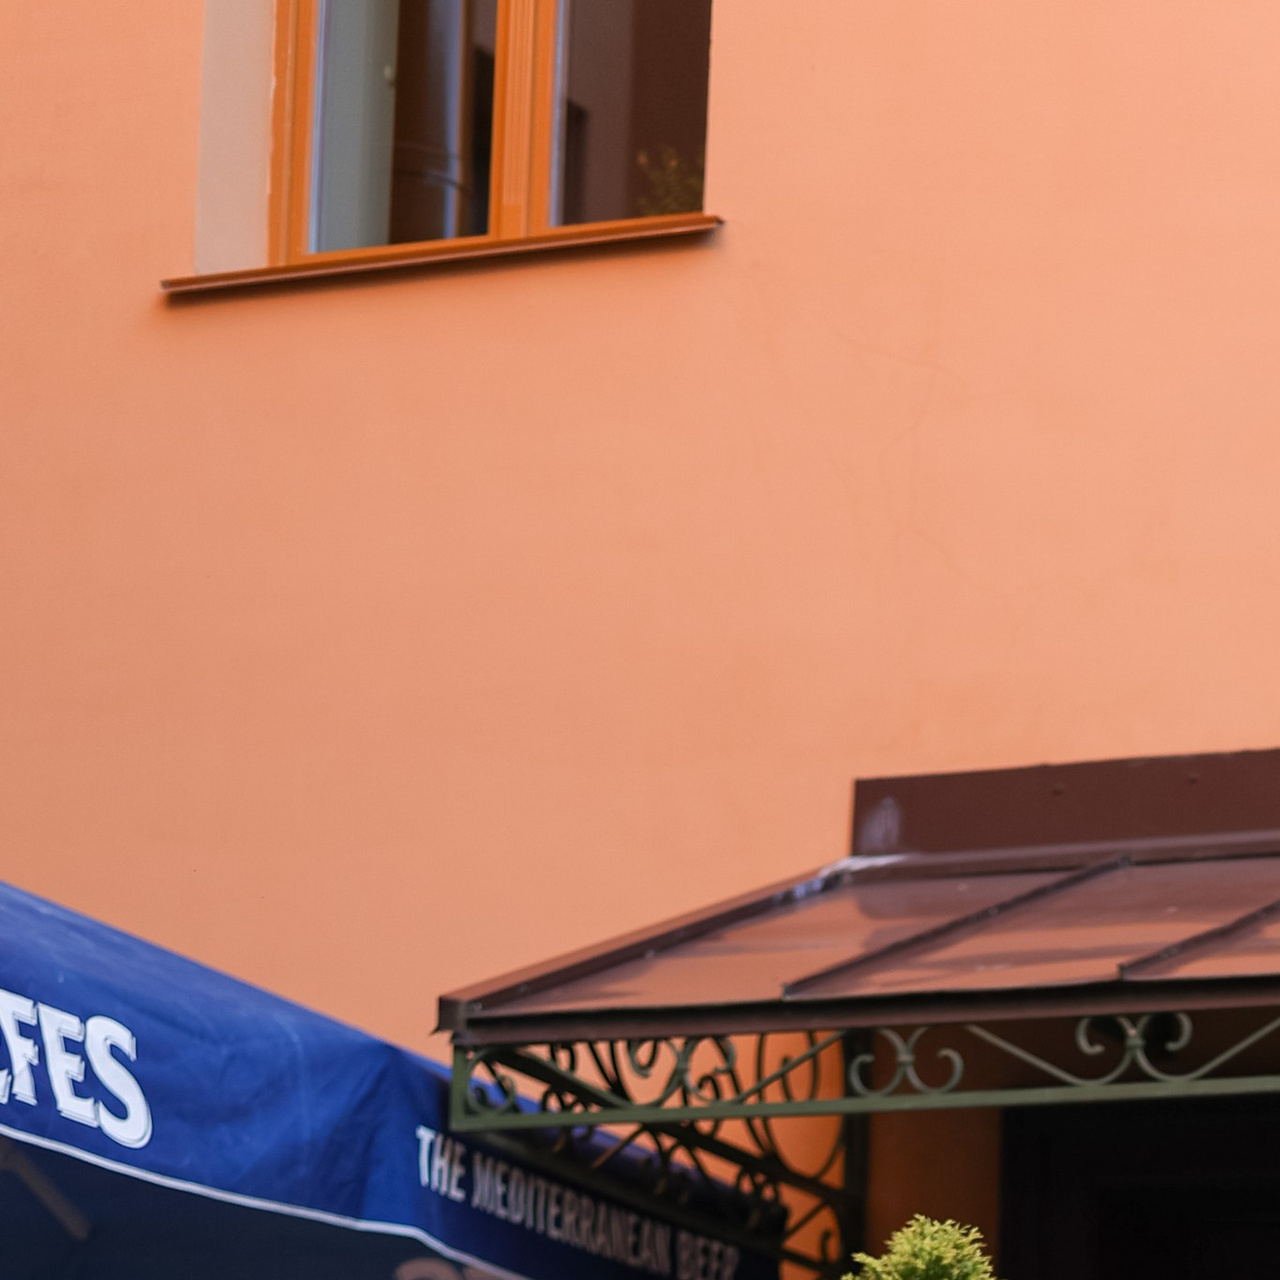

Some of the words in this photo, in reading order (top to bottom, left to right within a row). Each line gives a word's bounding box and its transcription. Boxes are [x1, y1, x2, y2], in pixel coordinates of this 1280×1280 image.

[0, 987, 153, 1149] FES
[415, 1125, 467, 1203] THE
[471, 1151, 671, 1277] MEDITERRANEAN
